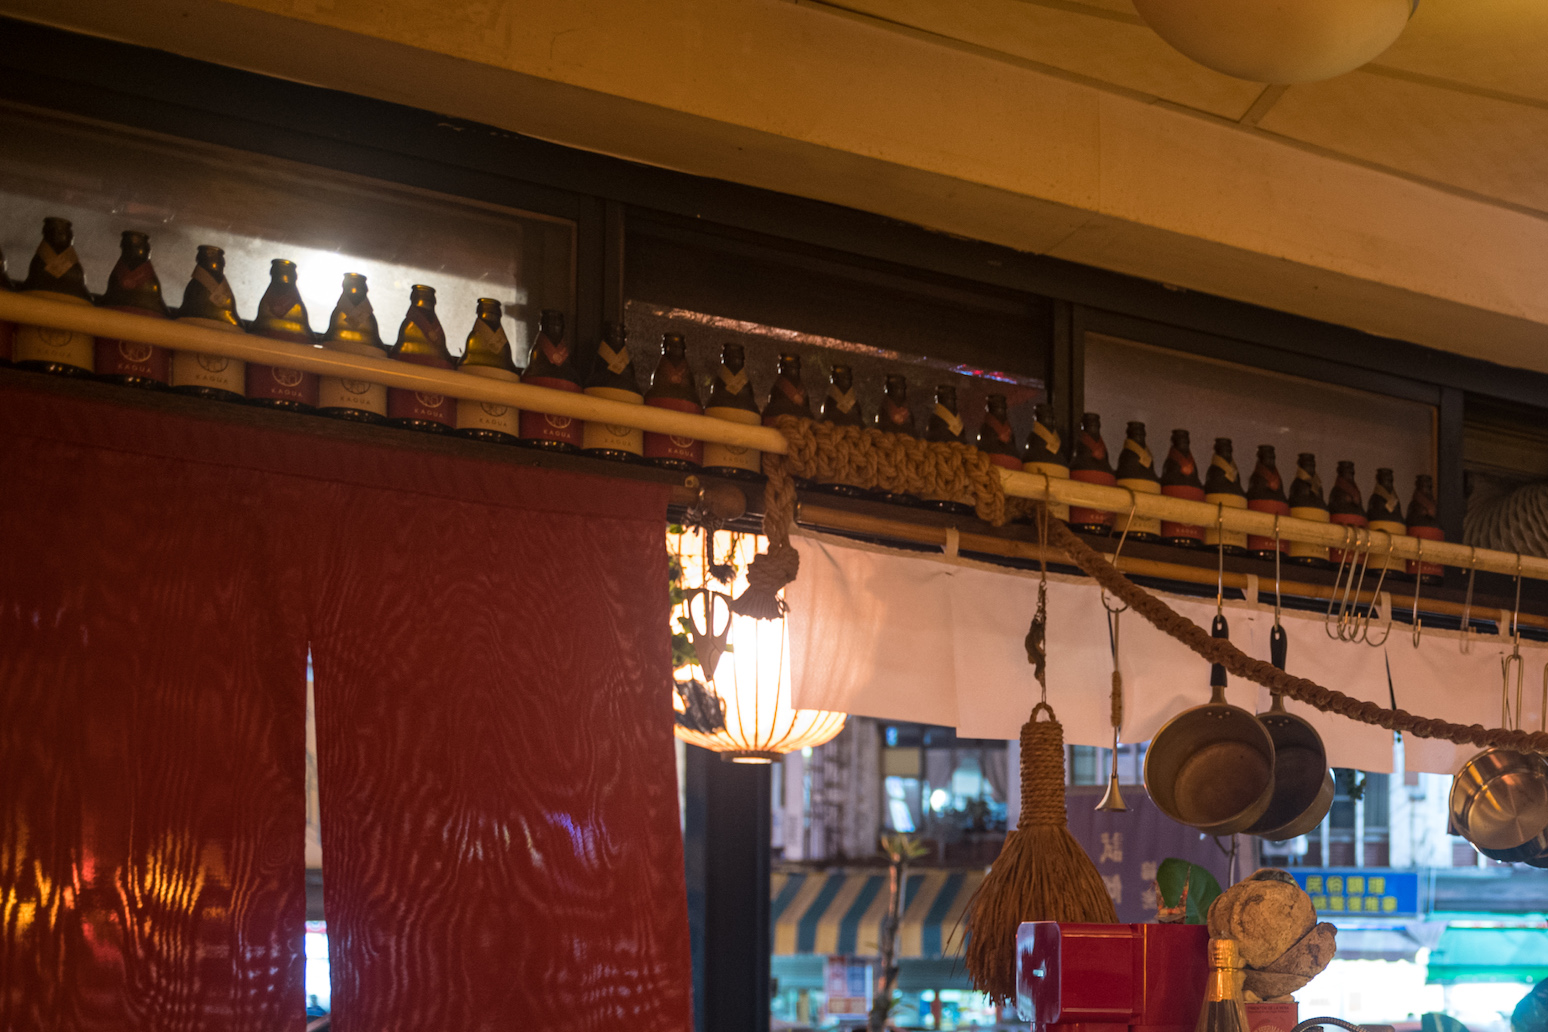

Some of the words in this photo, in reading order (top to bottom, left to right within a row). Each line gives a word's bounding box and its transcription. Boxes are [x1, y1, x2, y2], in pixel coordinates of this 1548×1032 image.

[117, 362, 152, 374] KAGUA
[194, 373, 229, 385] KAGUA
[271, 387, 304, 398] KAGUA
[339, 396, 371, 406] KAGUA
[414, 408, 444, 418] KAGUA
[478, 417, 508, 427] KAGUA
[543, 428, 571, 439] KAGUA
[603, 437, 633, 447] KAGUA
[667, 447, 694, 458] KAGUA
[722, 455, 750, 466] KAGUA
